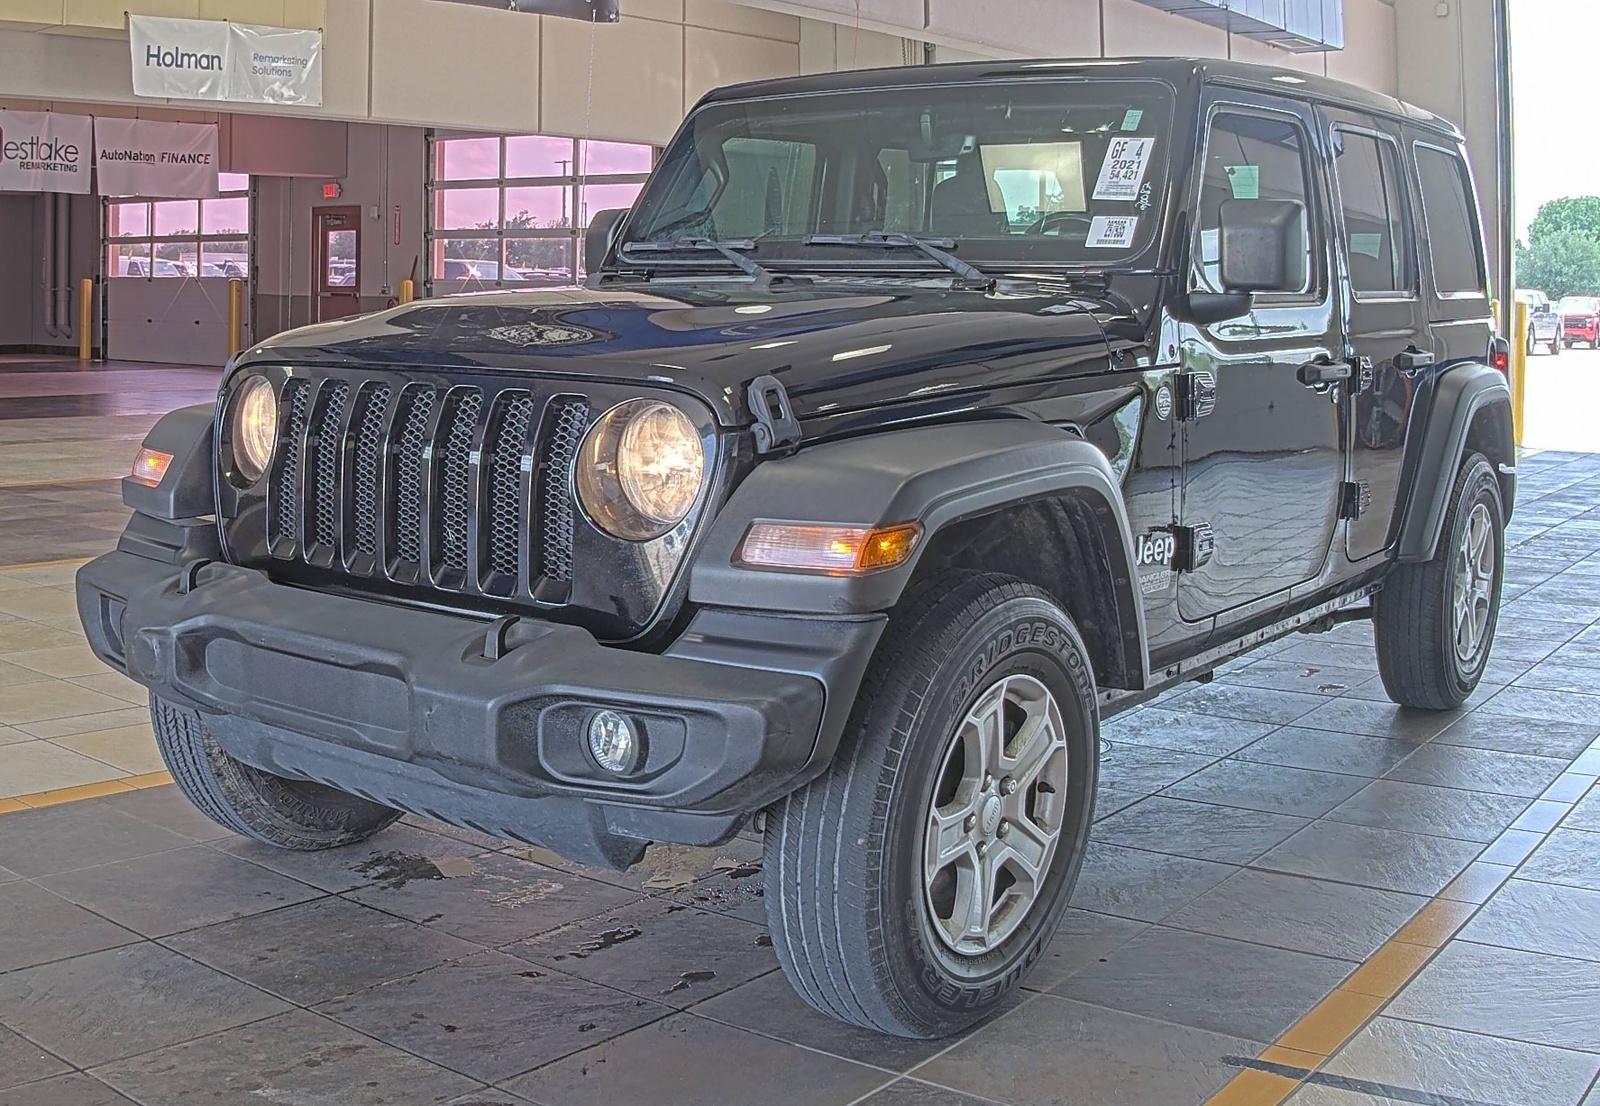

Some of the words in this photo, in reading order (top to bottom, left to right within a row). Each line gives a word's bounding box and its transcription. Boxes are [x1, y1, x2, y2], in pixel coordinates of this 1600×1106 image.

[146, 45, 223, 71] Holman
[253, 53, 308, 68] Remarketing
[252, 66, 293, 77] Solutions
[3, 136, 79, 163] estlake
[100, 149, 156, 163] AutoNation
[161, 152, 211, 164] FINANCE
[1111, 141, 1128, 160] GF
[1135, 141, 1145, 160] 4
[20, 162, 78, 173] REMARKETING
[1111, 159, 1142, 170] 2021
[1109, 170, 1139, 182] 54,421
[1136, 535, 1175, 566] Jeep
